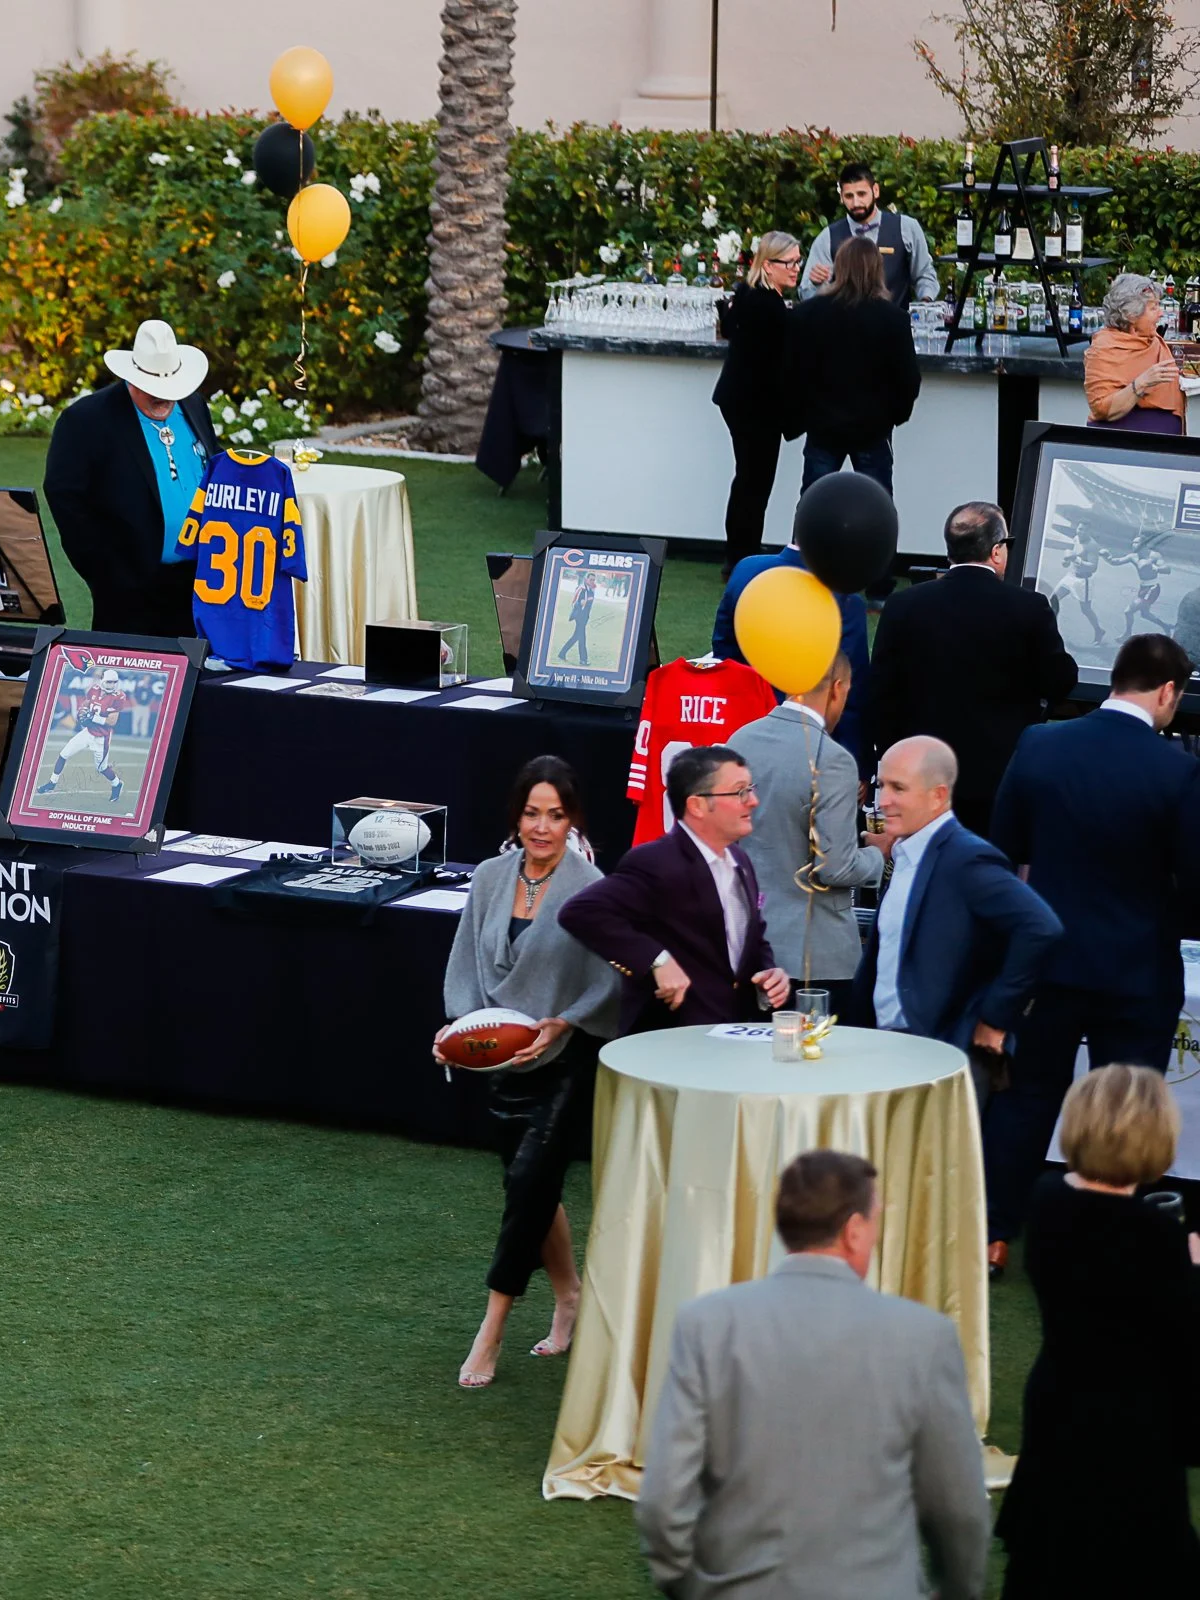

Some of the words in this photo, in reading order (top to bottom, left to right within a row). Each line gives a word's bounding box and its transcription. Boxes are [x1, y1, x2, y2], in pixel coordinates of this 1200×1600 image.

[204, 483, 266, 514] GURLEY
[268, 491, 280, 517] II
[193, 520, 277, 611] 30
[589, 553, 633, 568] BEARS
[97, 655, 122, 666] KURT
[123, 656, 163, 669] WARNER
[680, 695, 727, 724] RICE
[48, 812, 64, 820] 2017
[64, 813, 82, 822] HALL
[83, 815, 93, 823] OF
[93, 816, 113, 825] FAME
[62, 822, 96, 832] INDUCTEE
[317, 867, 403, 880] RAIDERS
